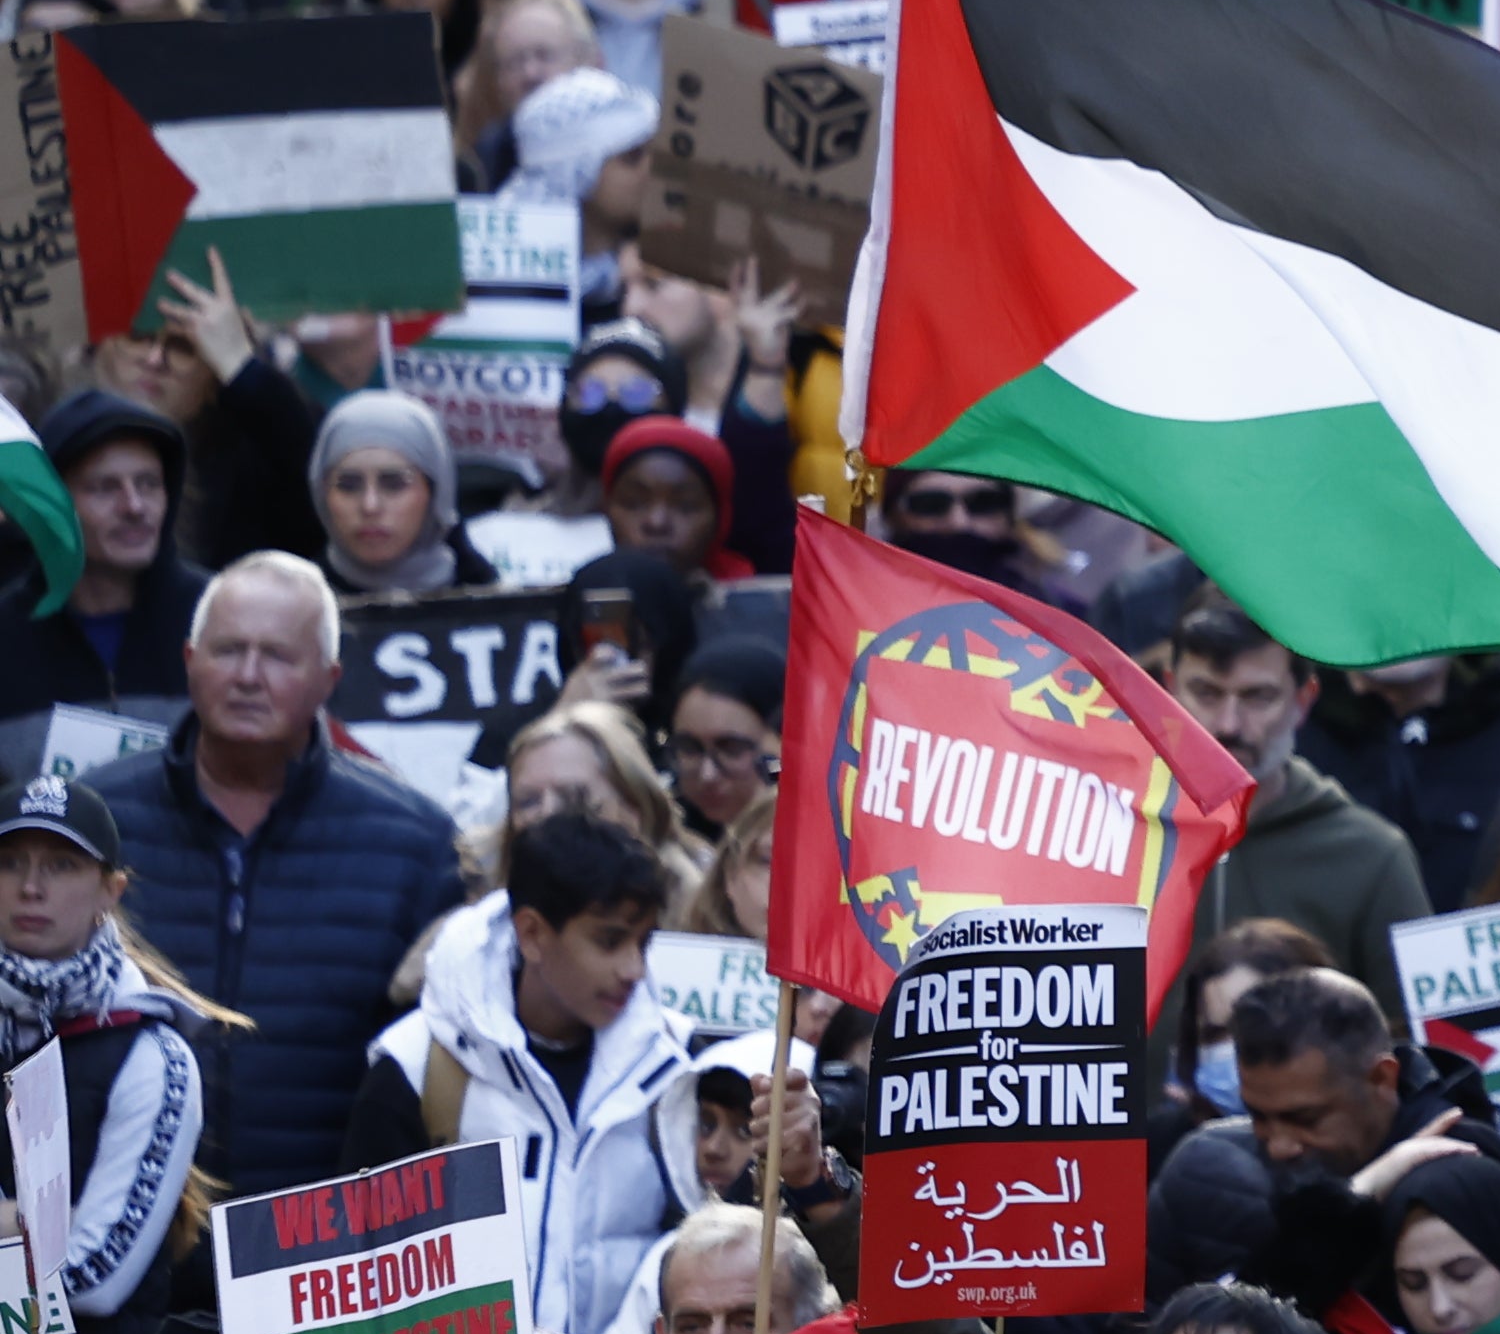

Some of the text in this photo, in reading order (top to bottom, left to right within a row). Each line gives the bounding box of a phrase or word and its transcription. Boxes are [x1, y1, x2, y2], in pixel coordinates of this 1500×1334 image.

[462, 244, 572, 274] ESTINE
[861, 717, 1137, 876] REVOLUTION
[919, 916, 1104, 957] Socialist Worker
[894, 964, 1115, 1039] FREEDOM
[980, 1029, 1019, 1061] for
[878, 1062, 1128, 1138] PALESTINE
[272, 1155, 447, 1250] WE WANT
[913, 1155, 1082, 1220] الحرية
[290, 1233, 456, 1325] FREEDOM
[893, 1220, 1106, 1289] لفلسطين
[956, 1281, 1038, 1306] swp.org.uk
